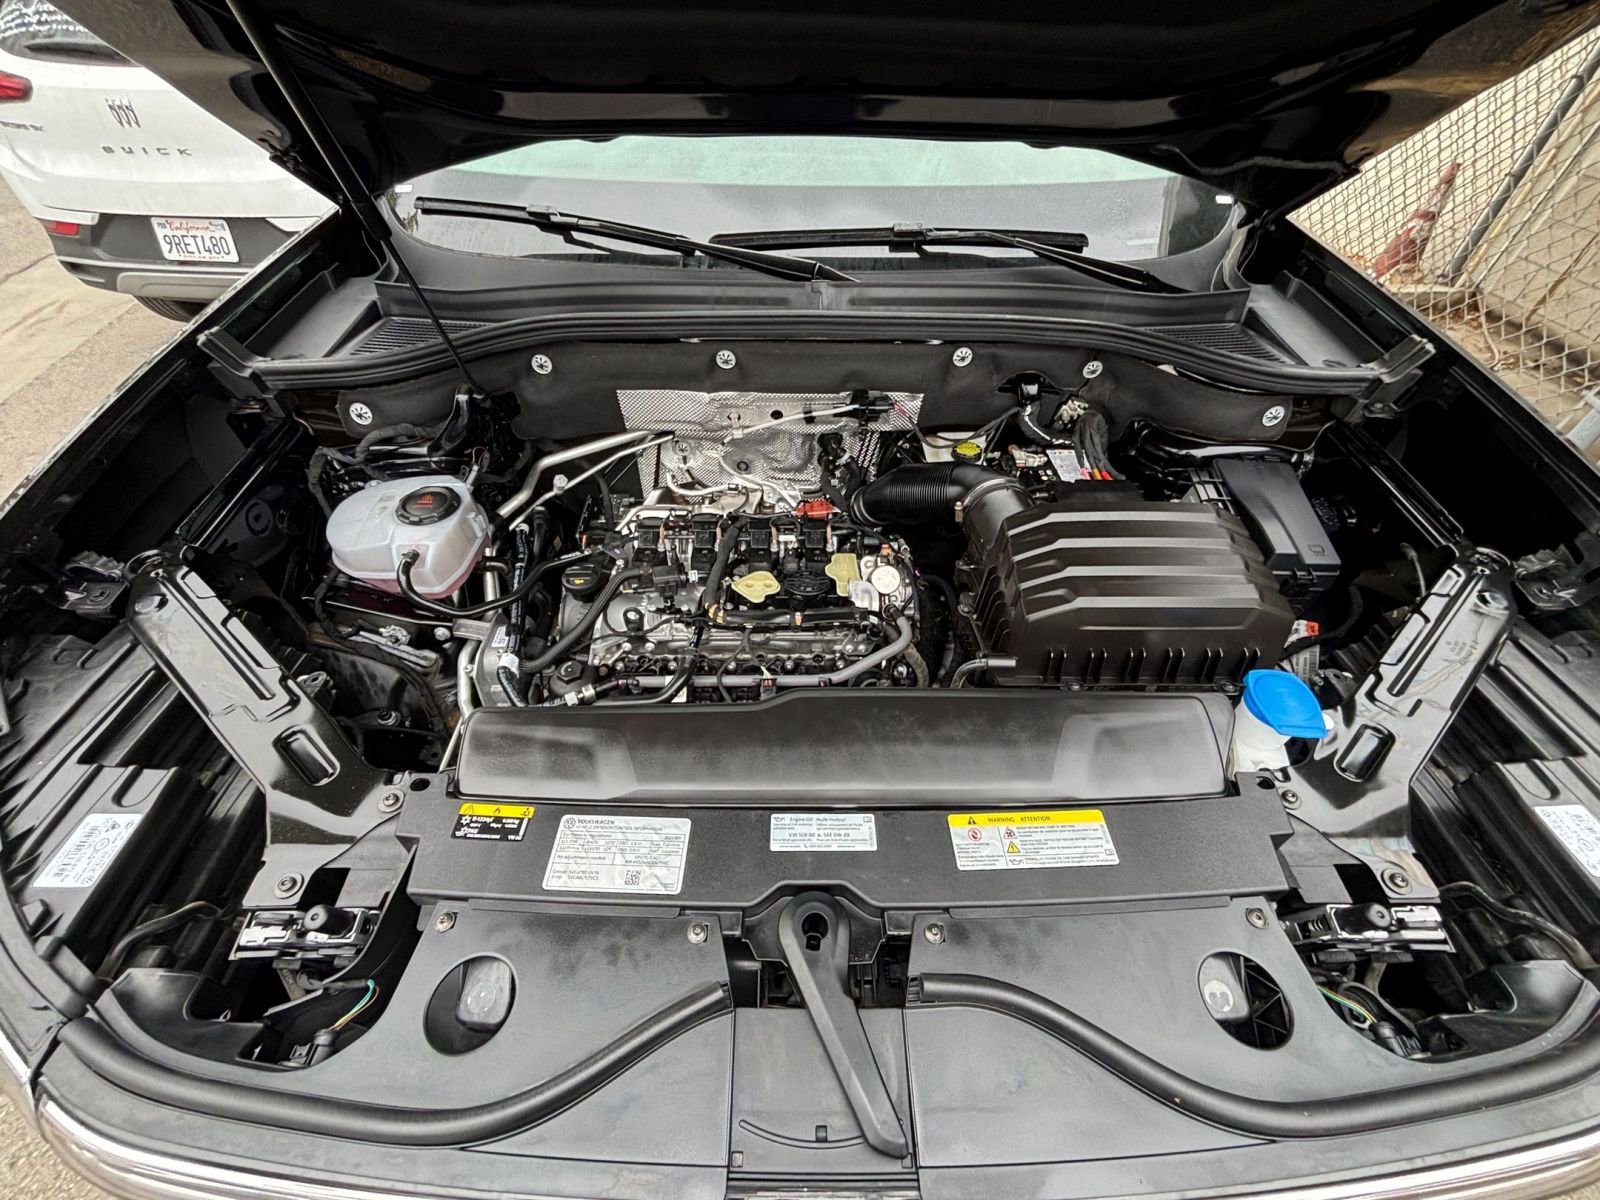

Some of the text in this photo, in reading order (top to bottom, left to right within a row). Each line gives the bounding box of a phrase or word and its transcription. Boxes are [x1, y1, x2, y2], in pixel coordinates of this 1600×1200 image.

[102, 146, 192, 156] BUICK
[165, 220, 210, 234] California
[163, 234, 231, 256] 9RET480
